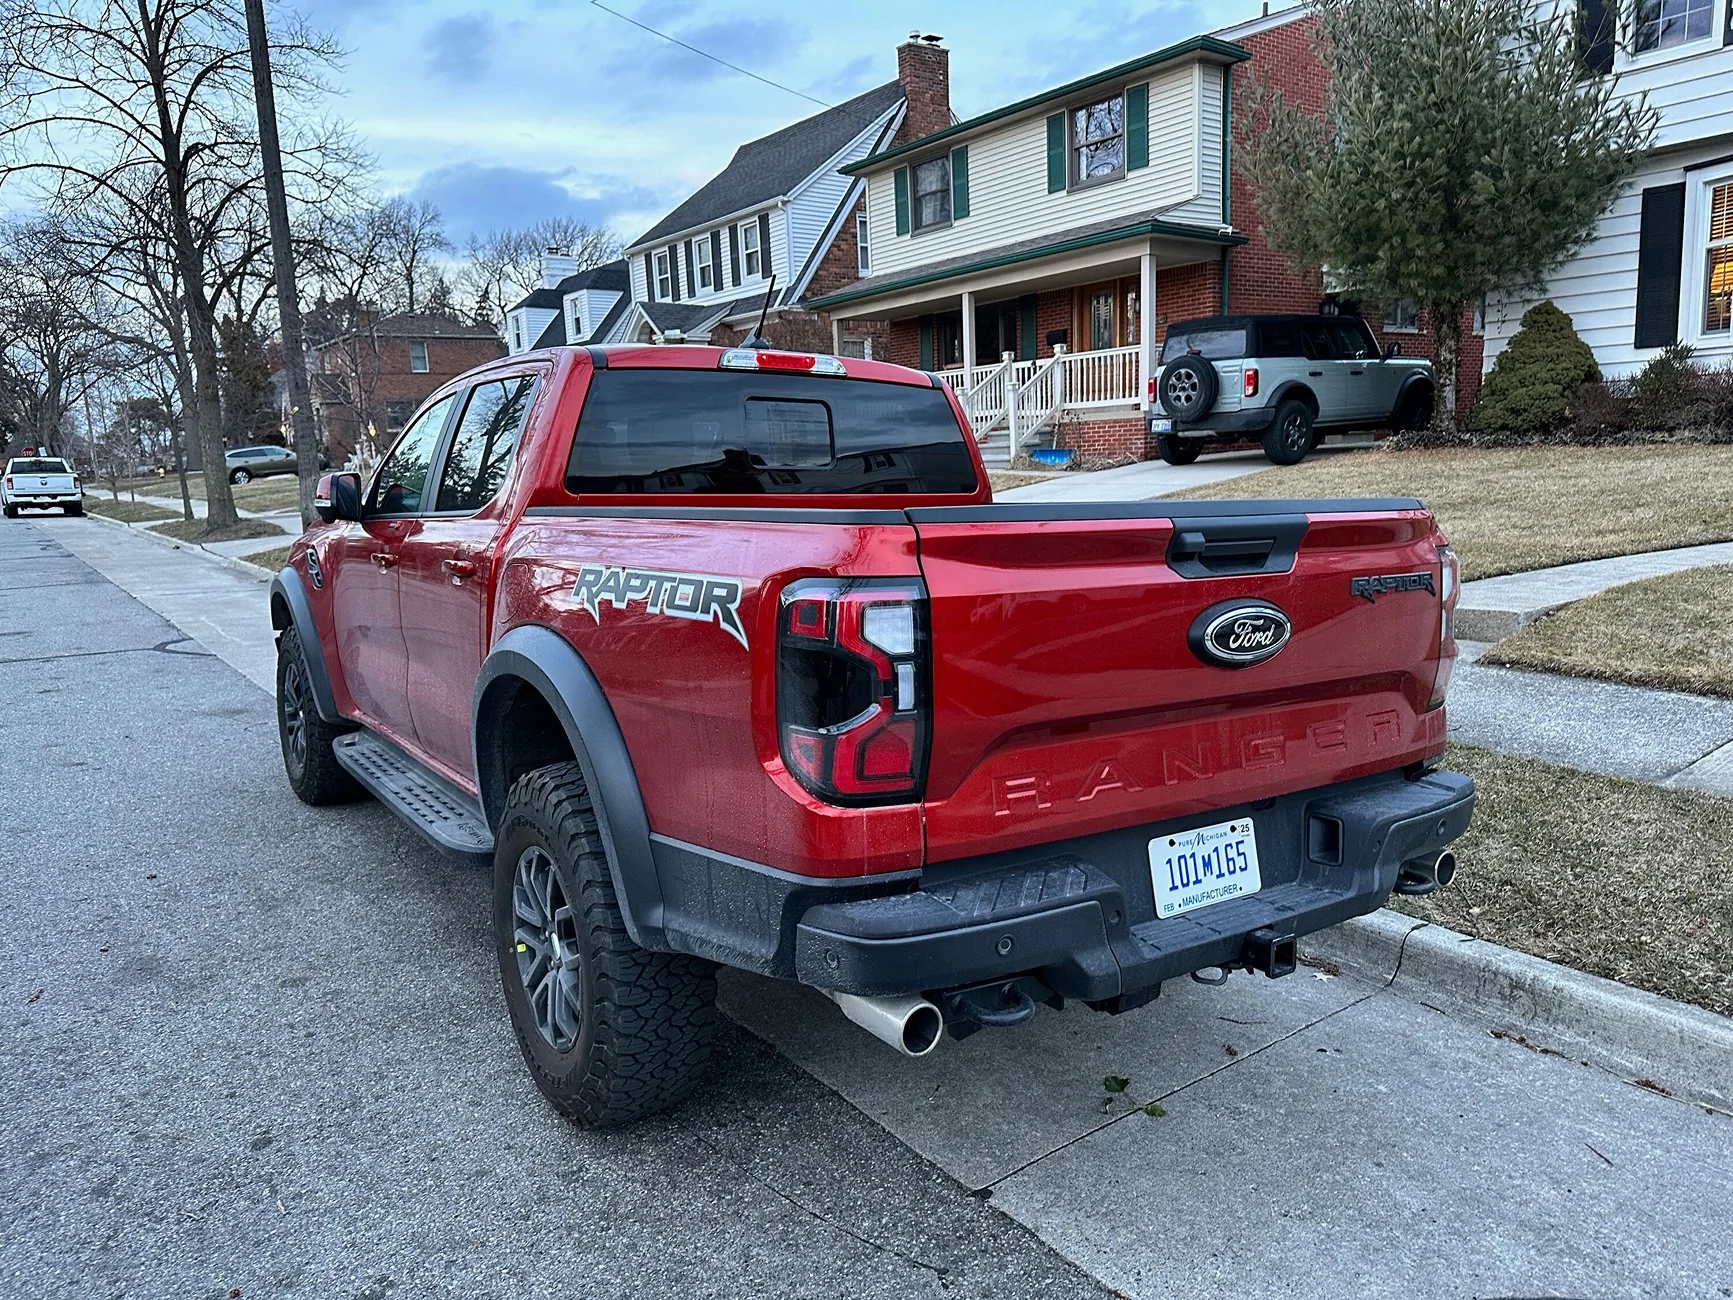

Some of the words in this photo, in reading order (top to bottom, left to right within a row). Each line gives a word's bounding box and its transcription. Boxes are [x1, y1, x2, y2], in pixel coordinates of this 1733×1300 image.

[1351, 571, 1437, 604] RAPTOR
[571, 563, 749, 651] RAPTOR
[1228, 618, 1274, 649] Ford
[991, 708, 1400, 816] RANGER
[1178, 839, 1193, 848] PURE
[1191, 831, 1228, 850] MICHIGAN
[1240, 823, 1250, 833] 25
[1165, 840, 1248, 892] 101M165
[1163, 902, 1175, 913] FEB
[1182, 884, 1238, 907] MANUFACTURER
